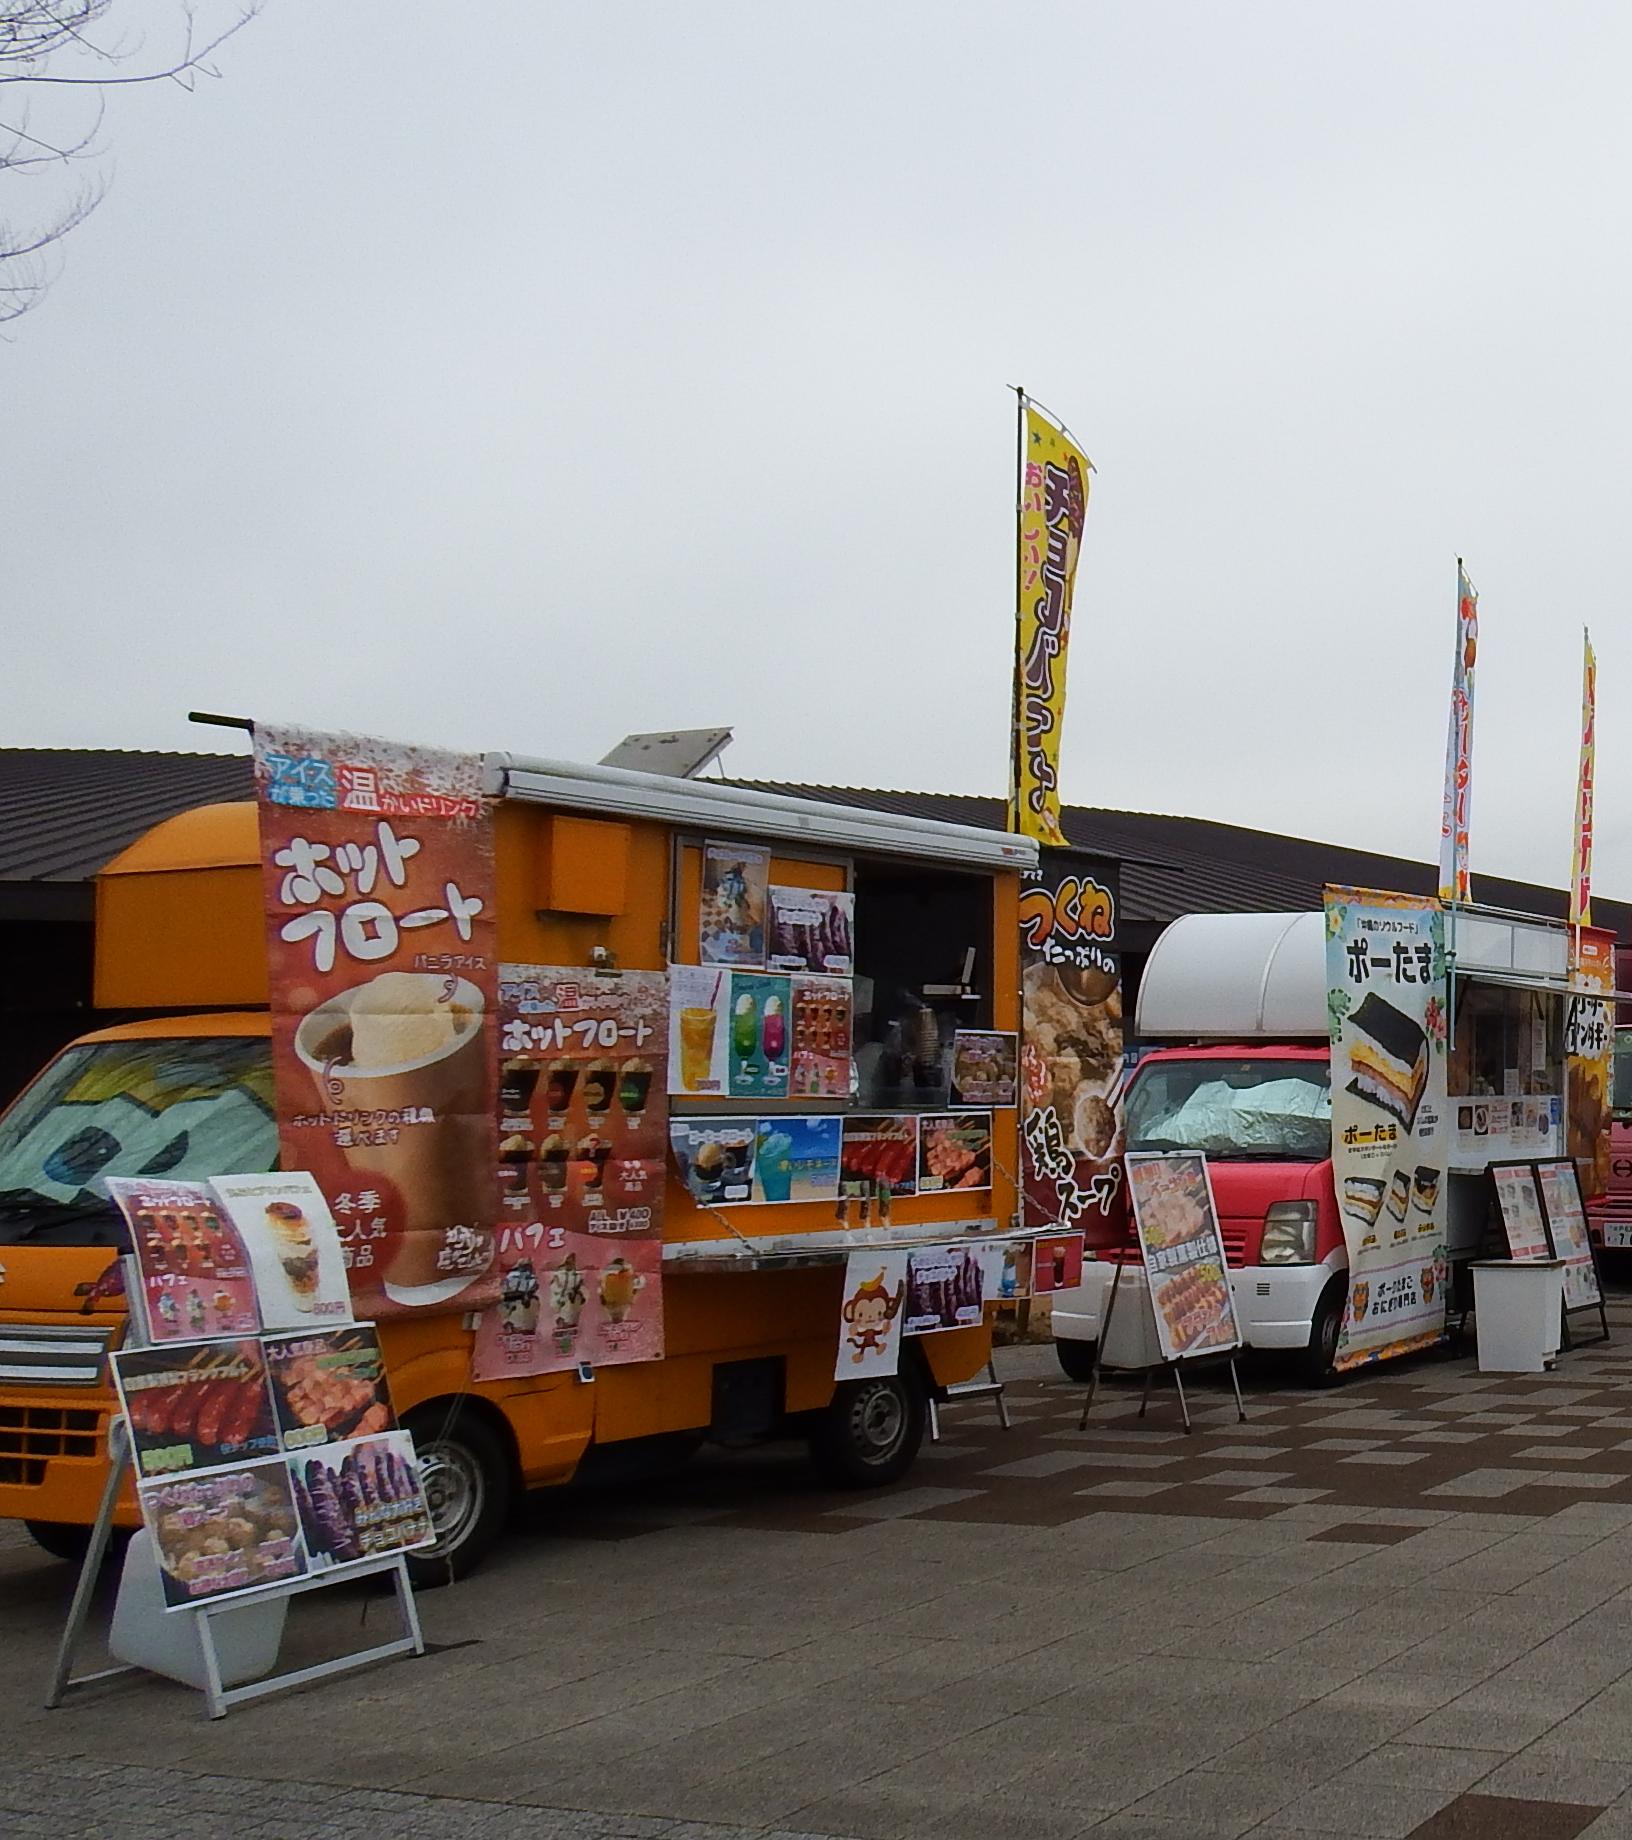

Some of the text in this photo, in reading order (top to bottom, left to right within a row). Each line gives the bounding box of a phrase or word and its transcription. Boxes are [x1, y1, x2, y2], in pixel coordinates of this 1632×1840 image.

[266, 756, 334, 786] アイス
[274, 821, 421, 906] ホット
[281, 882, 484, 973] フロート
[1019, 876, 1115, 950] つくね
[414, 953, 488, 970] バニラアイス
[1043, 937, 1115, 974] たっぷりの
[502, 1018, 654, 1050] ホットフロート
[1344, 1123, 1397, 1145] ポーたま
[334, 1190, 381, 1215] 冬季
